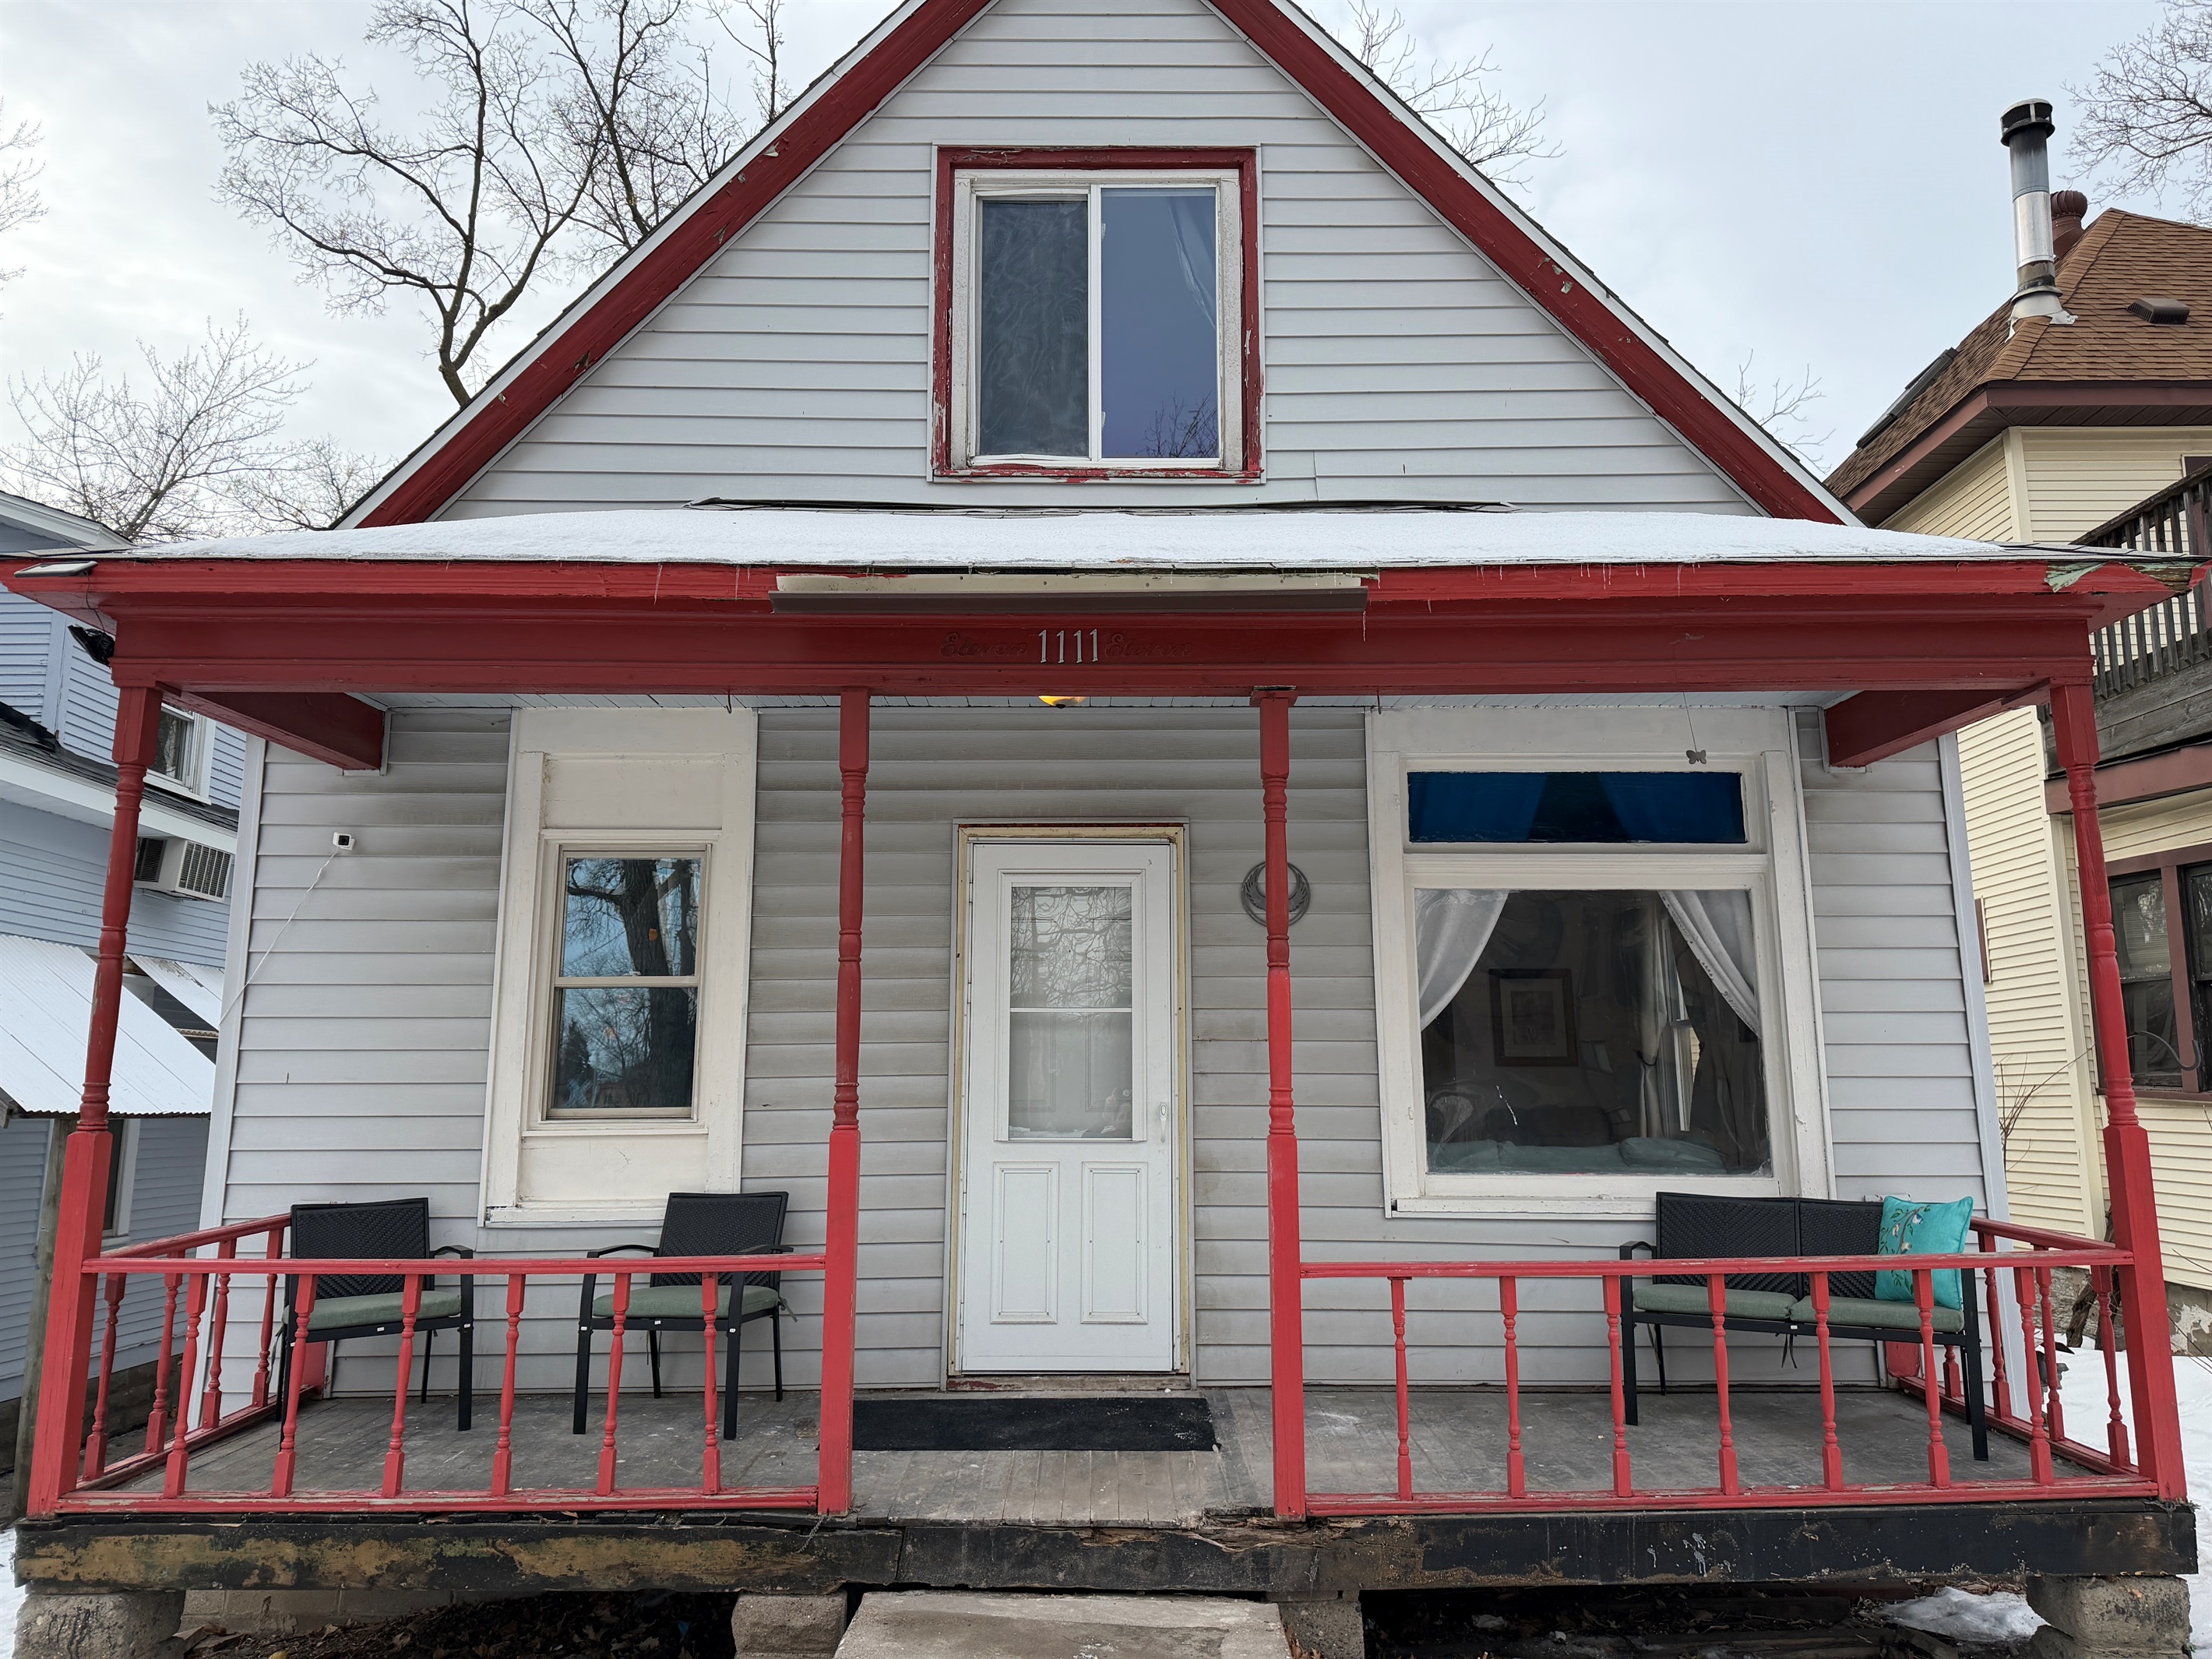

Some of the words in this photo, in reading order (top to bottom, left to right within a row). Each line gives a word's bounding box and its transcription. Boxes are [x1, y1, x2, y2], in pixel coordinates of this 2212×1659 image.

[939, 632, 1029, 657] Eleven
[1038, 629, 1099, 664] 1111
[1104, 633, 1192, 657] Eleven
